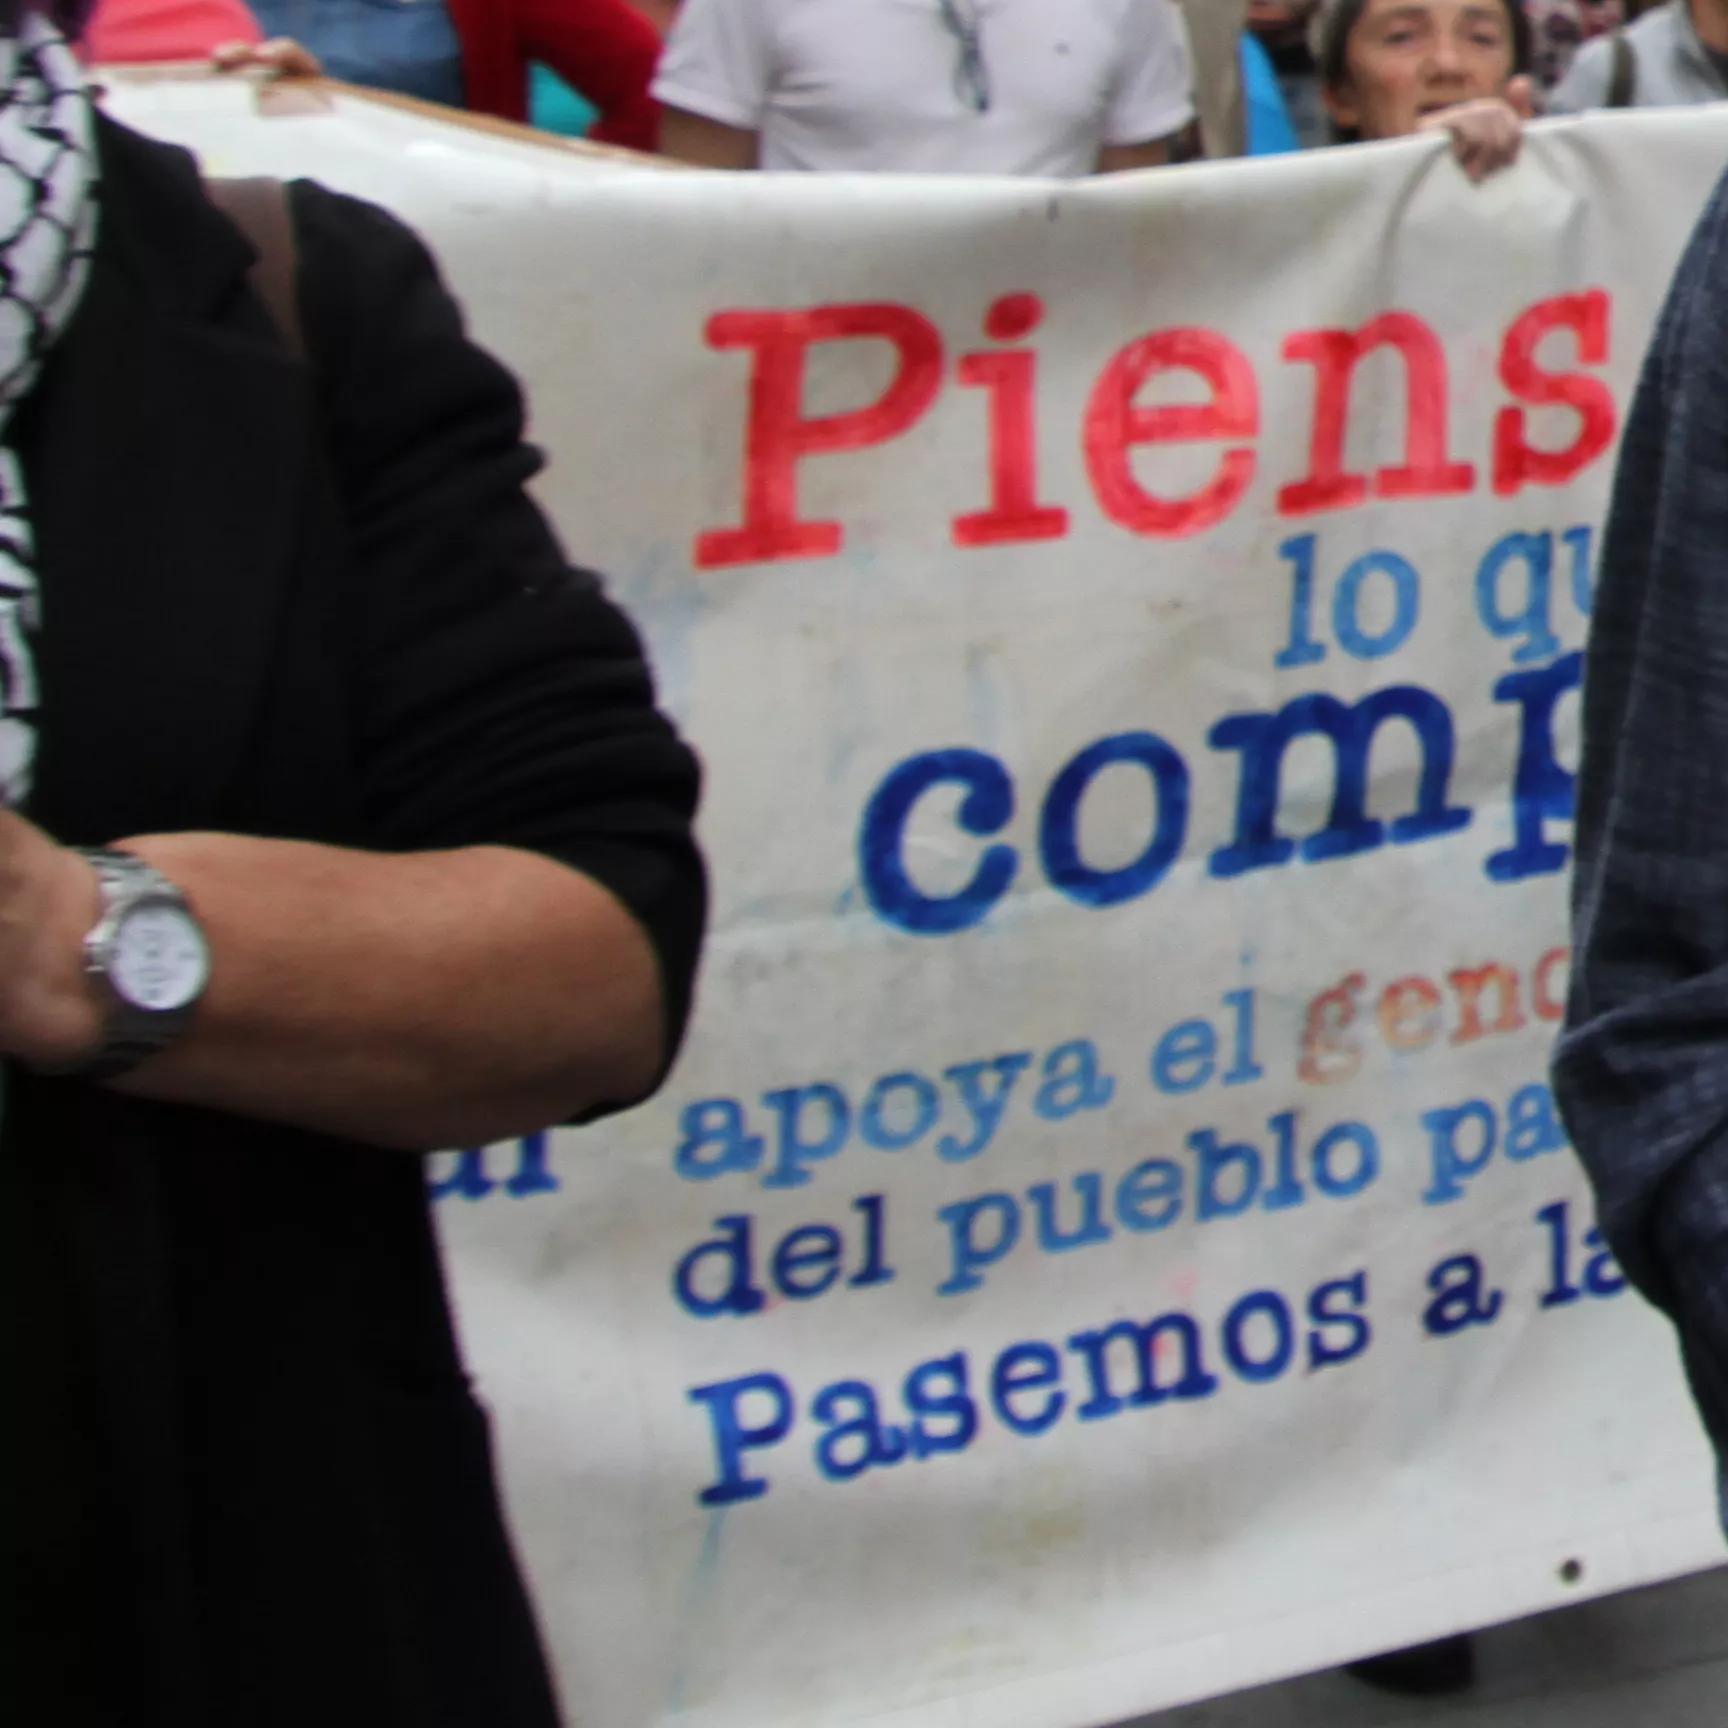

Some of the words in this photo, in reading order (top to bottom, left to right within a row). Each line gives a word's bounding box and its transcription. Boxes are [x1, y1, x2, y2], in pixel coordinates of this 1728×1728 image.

[690, 284, 1623, 574] Piens
[1274, 532, 1422, 670] lo
[673, 1038, 1117, 1191] apoya
[1150, 986, 1266, 1095] el
[673, 1194, 896, 1322] del
[936, 1110, 1383, 1298] pueblo
[685, 1270, 1372, 1510] Pasemos
[1423, 1252, 1505, 1337] a
